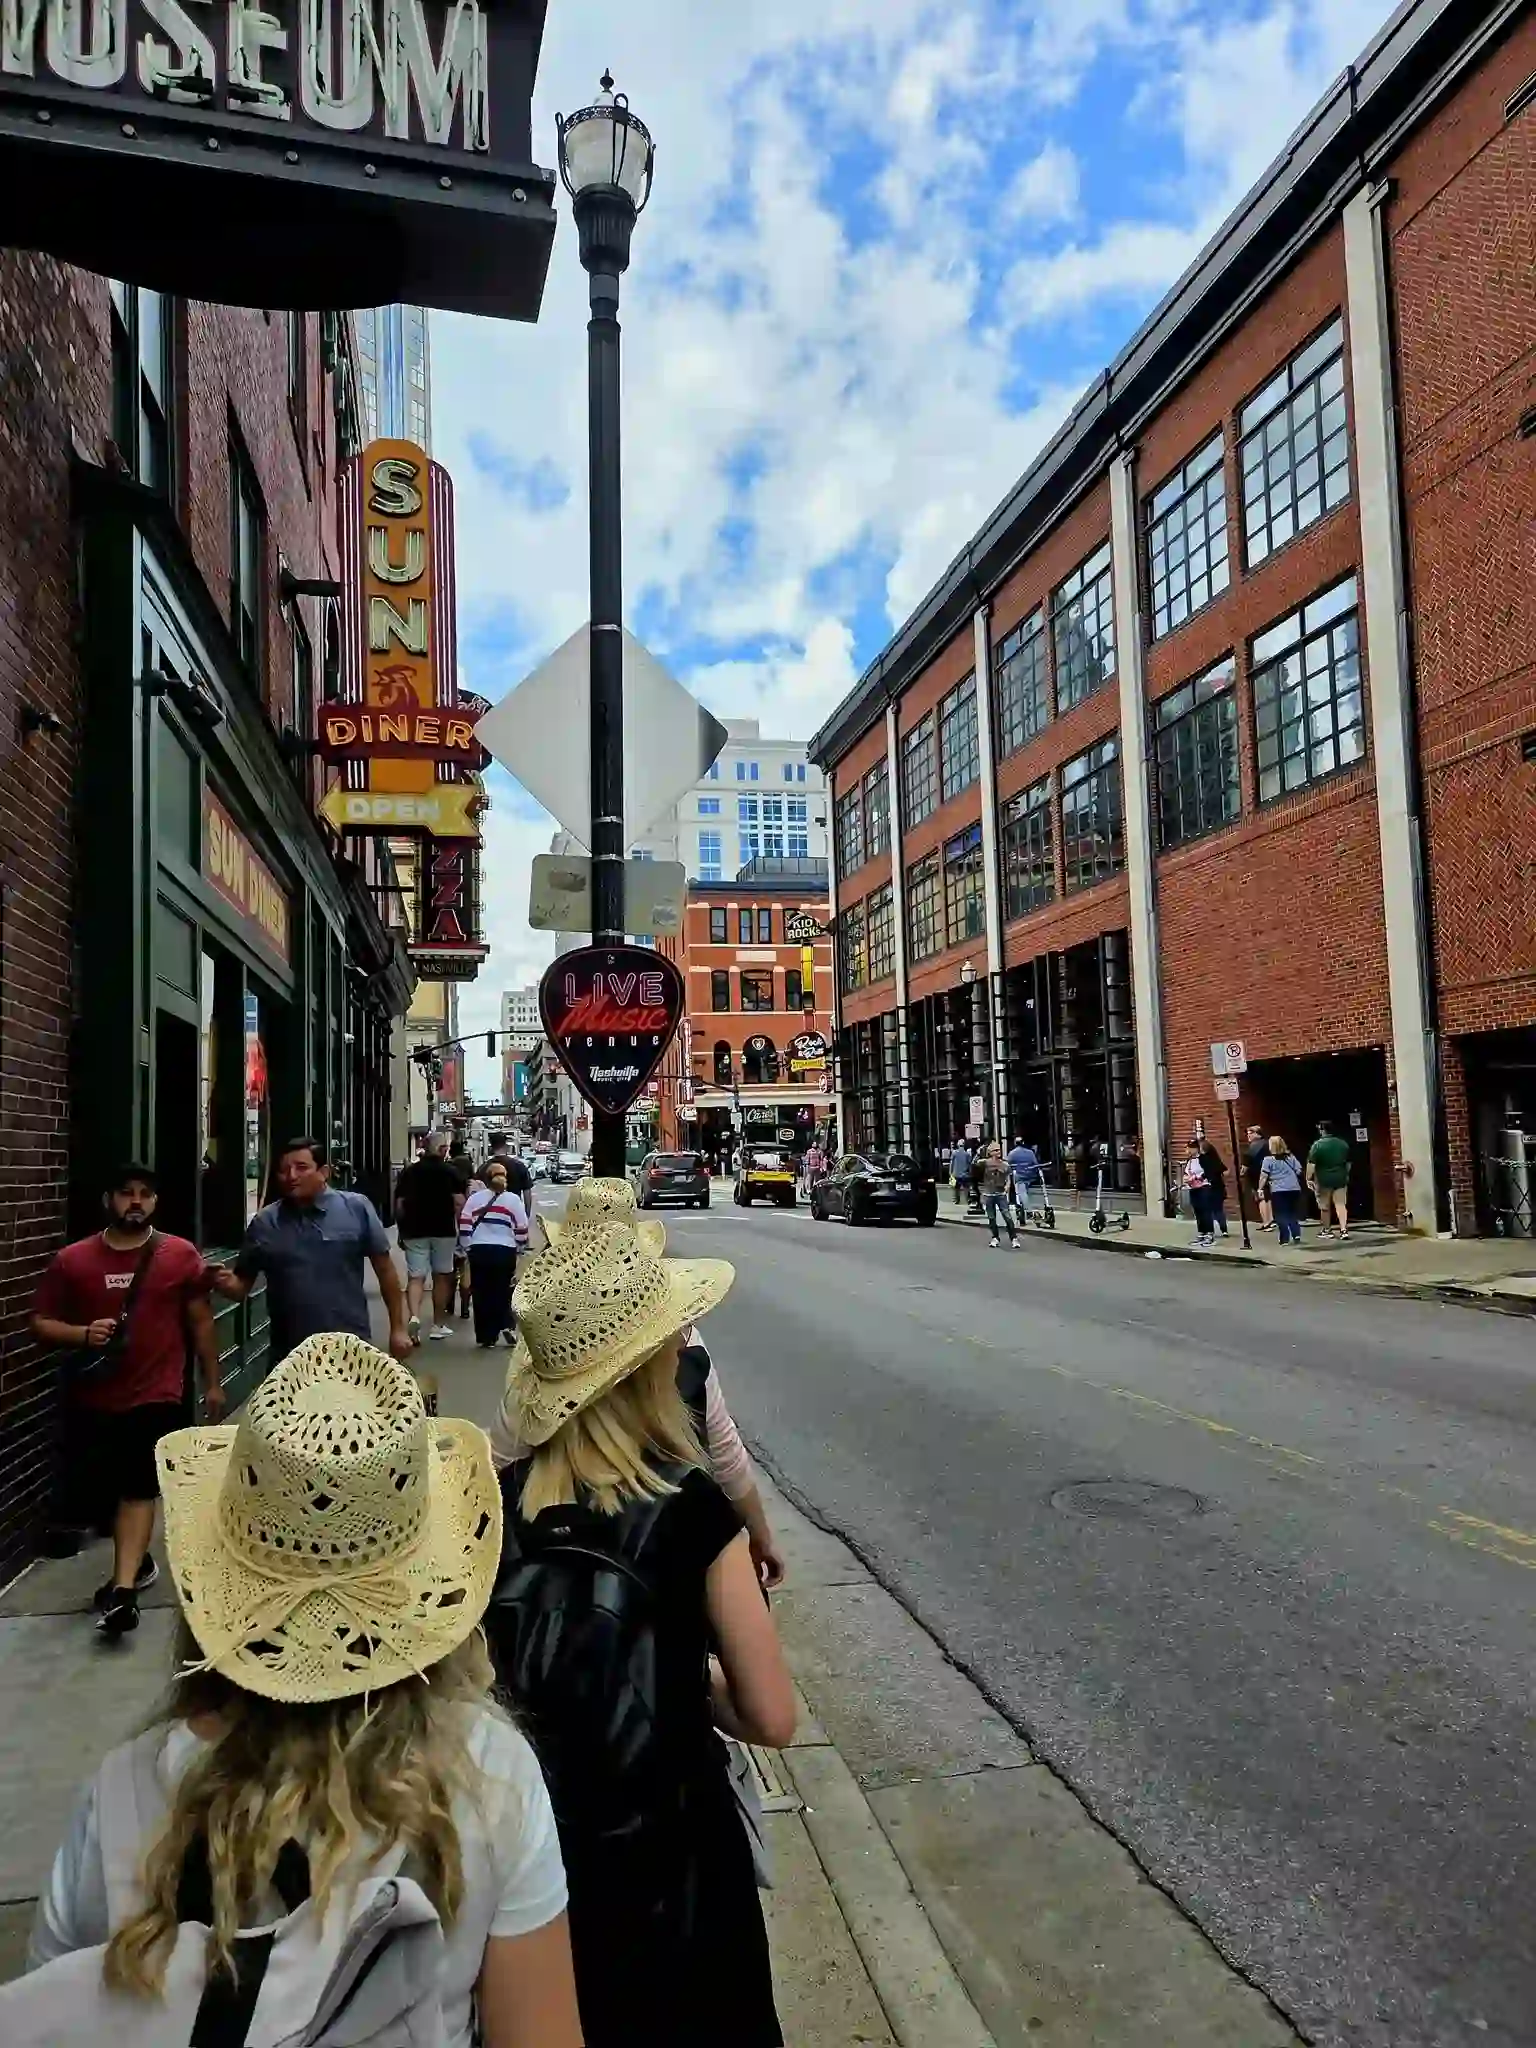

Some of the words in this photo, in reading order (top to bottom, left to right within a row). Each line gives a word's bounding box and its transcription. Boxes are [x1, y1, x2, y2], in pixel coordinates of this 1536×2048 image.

[368, 458, 429, 656] SUN
[327, 714, 473, 750] DINER
[346, 797, 441, 820] OPEN
[209, 808, 245, 904] SUN
[249, 857, 286, 949] DINER
[428, 844, 467, 942] ZZA
[793, 919, 813, 929] KID
[565, 972, 664, 1008] LIVE
[557, 993, 667, 1036] Music
[565, 1035, 660, 1048] venue
[589, 1065, 639, 1082] Nashville
